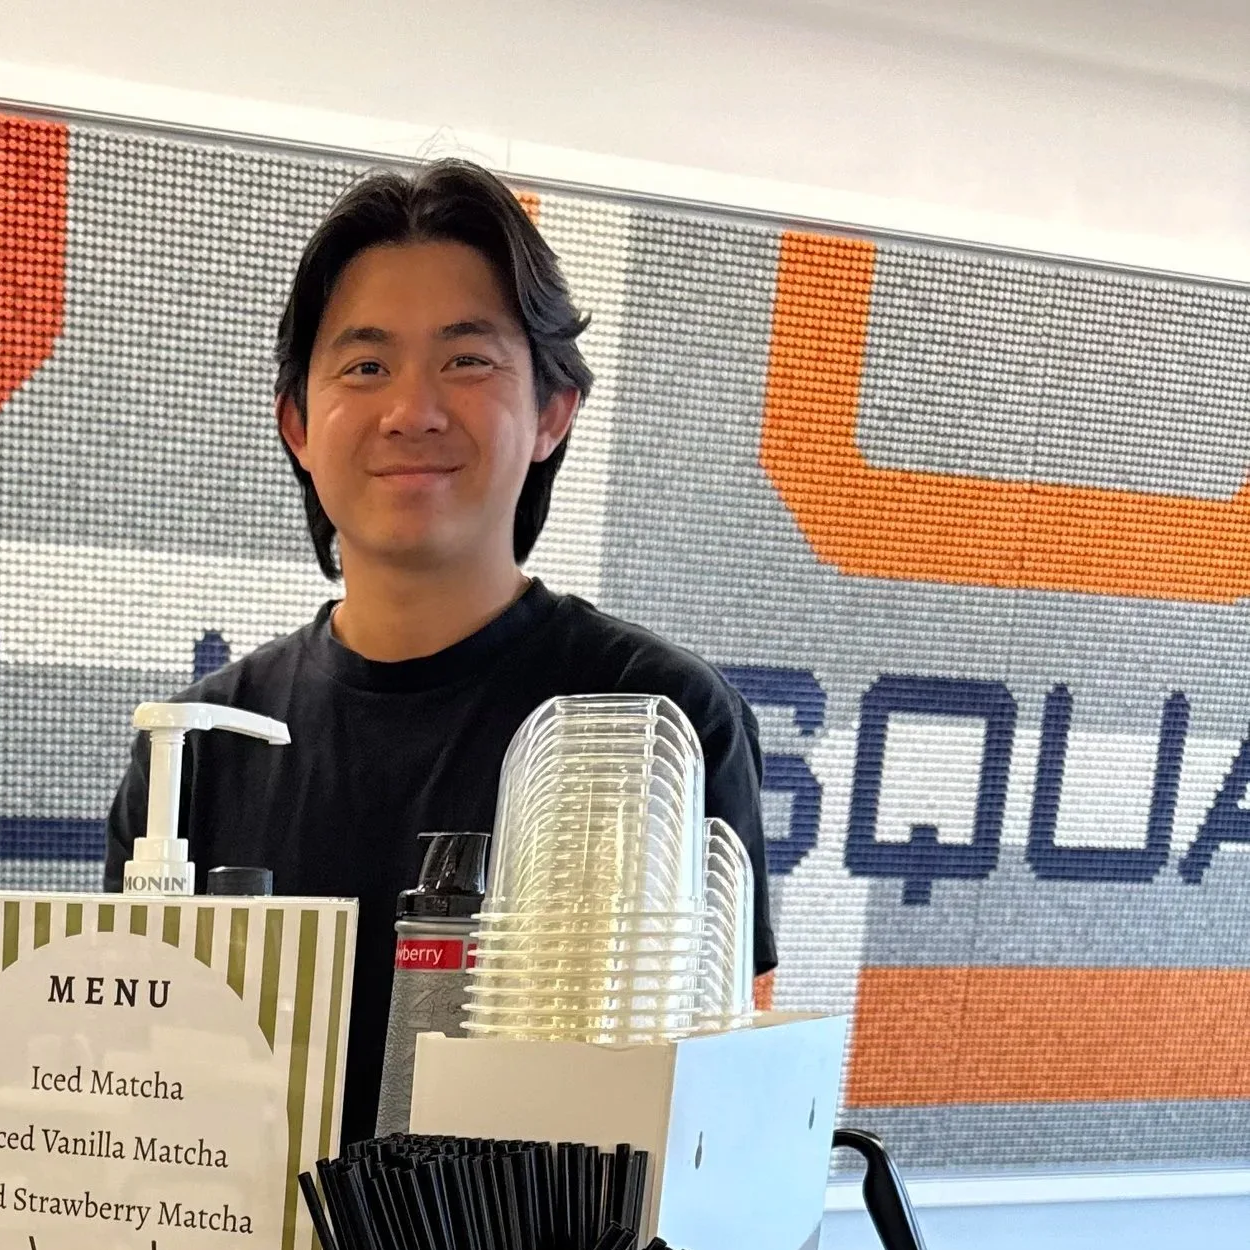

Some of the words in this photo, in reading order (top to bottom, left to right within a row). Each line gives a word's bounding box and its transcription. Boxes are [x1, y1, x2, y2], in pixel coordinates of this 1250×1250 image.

[47, 975, 171, 1009] MENU
[31, 1065, 83, 1093] Iced
[90, 1069, 184, 1101] Matcha
[41, 1128, 126, 1160] Vanilla
[132, 1136, 229, 1168] Matcha
[13, 1187, 151, 1231] Strawberry
[157, 1201, 254, 1235] Matcha
